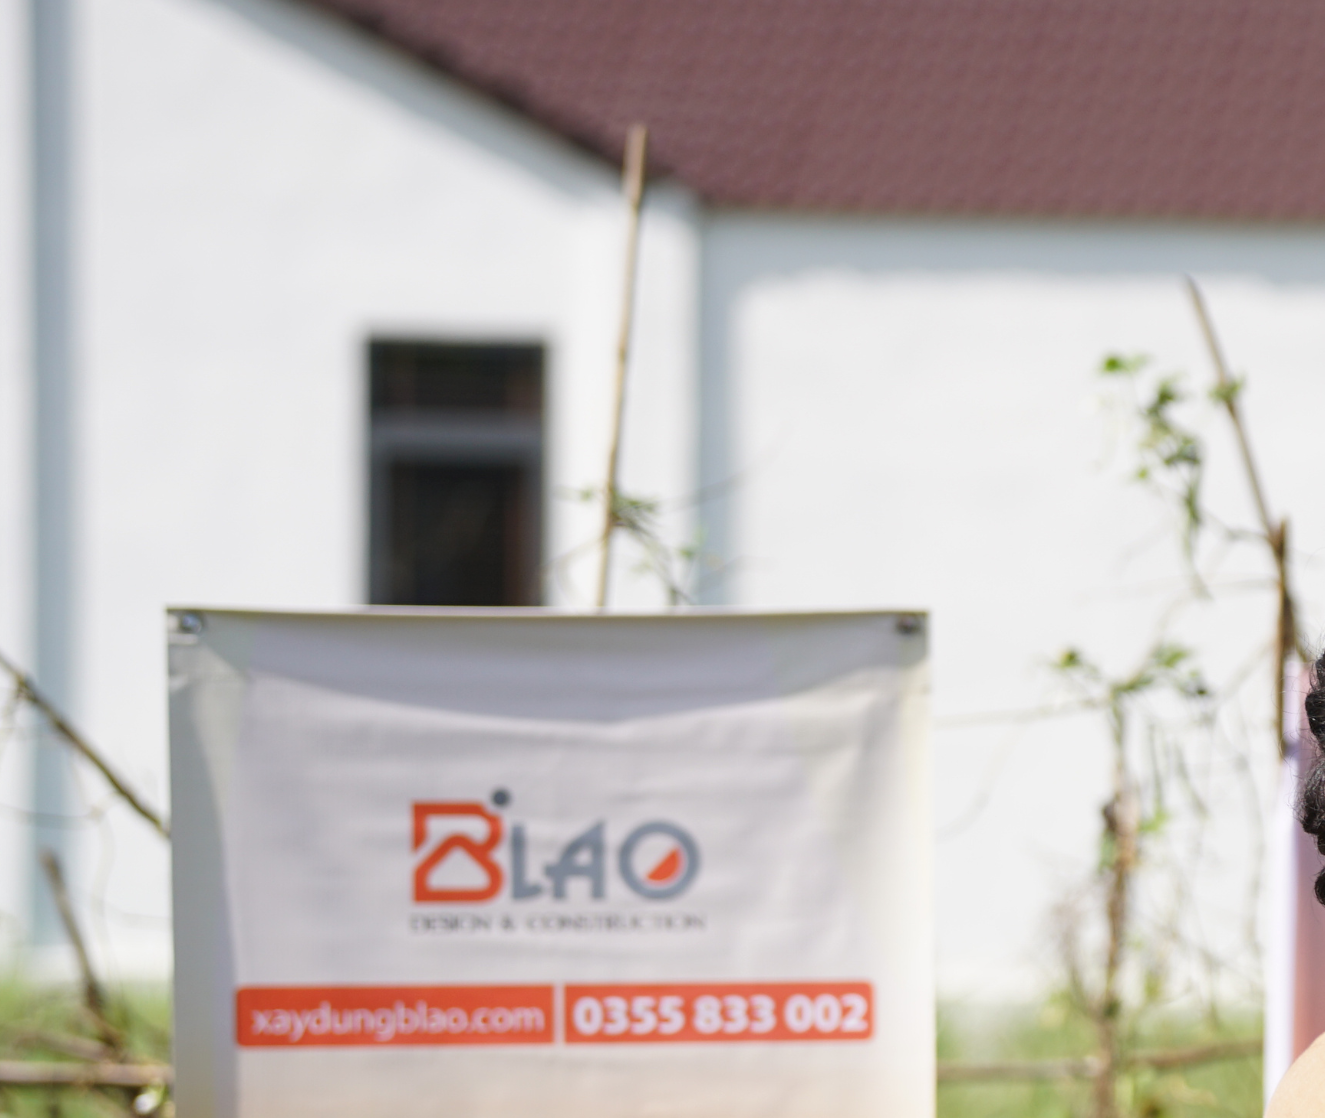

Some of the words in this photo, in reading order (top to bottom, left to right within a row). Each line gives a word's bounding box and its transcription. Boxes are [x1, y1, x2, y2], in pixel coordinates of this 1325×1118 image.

[251, 1001, 546, 1043] xaydungblao.com
[572, 995, 685, 1037] 0355
[692, 994, 776, 1034] 833
[783, 992, 868, 1033] 002
